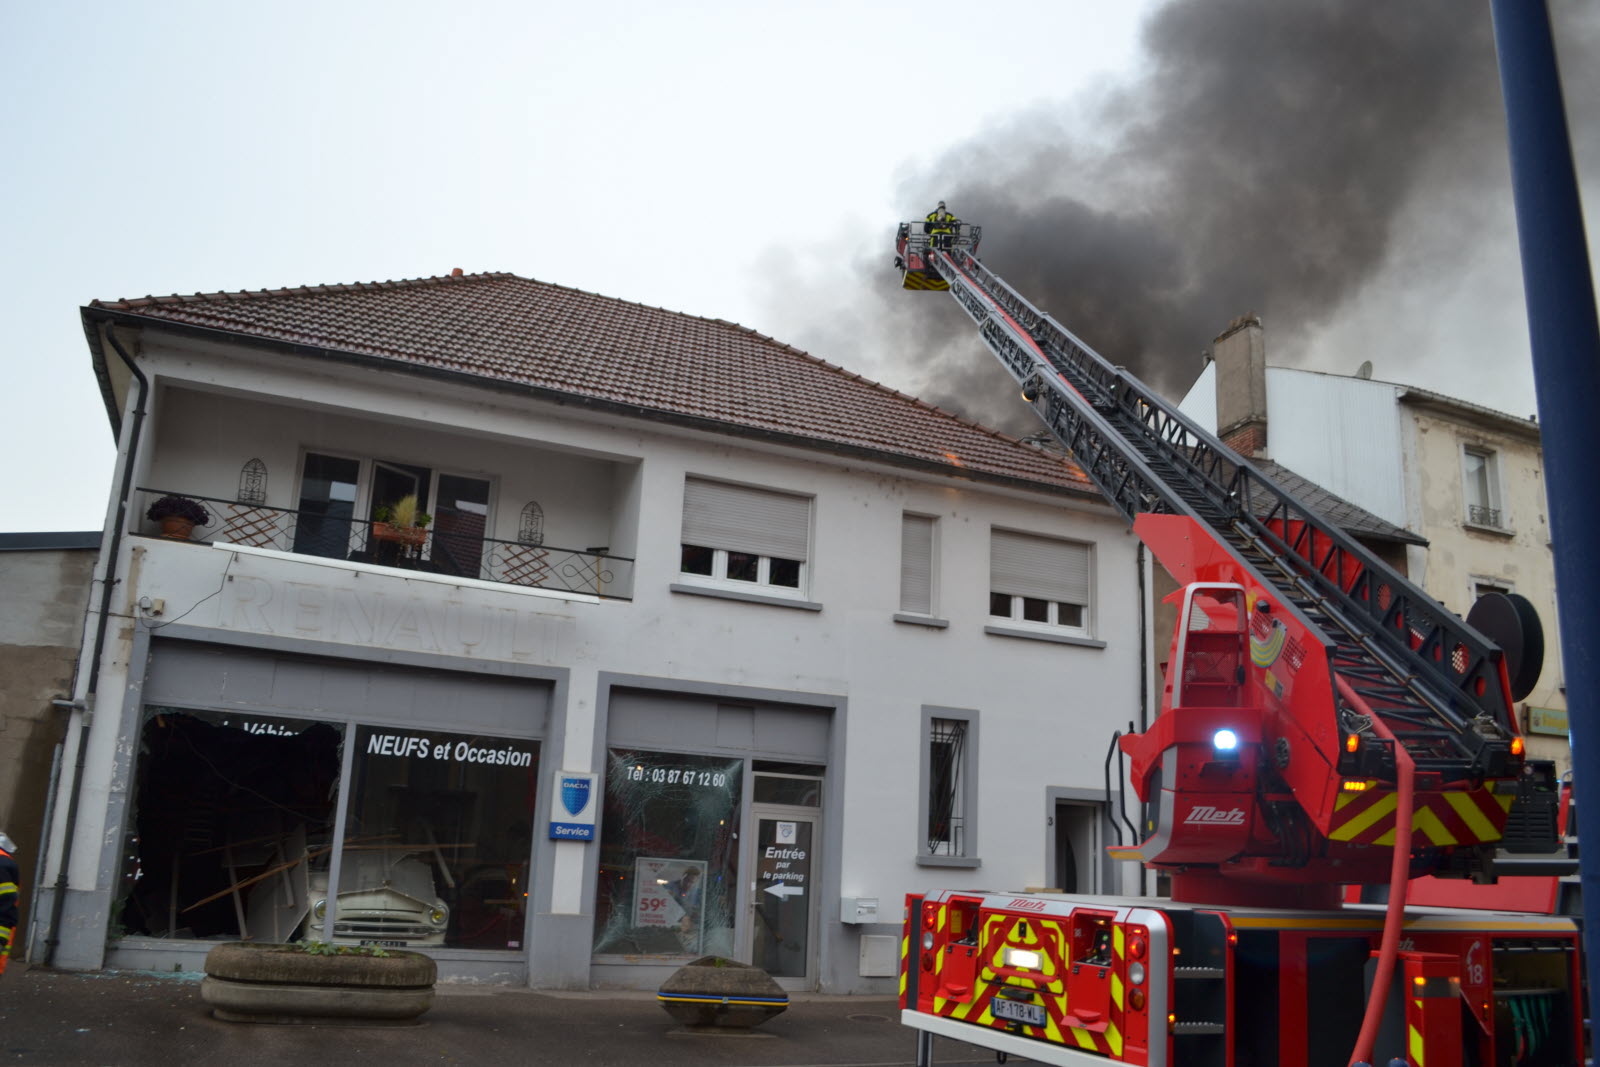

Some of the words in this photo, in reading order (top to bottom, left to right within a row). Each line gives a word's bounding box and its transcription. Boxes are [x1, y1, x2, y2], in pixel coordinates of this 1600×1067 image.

[367, 734, 430, 758] NEUFS
[433, 742, 450, 760] et
[454, 741, 532, 767] Occasion
[652, 768, 665, 782] 03
[667, 770, 681, 783] 87
[683, 771, 696, 784] 67
[698, 772, 711, 786] 12
[712, 773, 725, 787] 60
[1048, 816, 1054, 826] 3
[1184, 806, 1246, 825] Metz
[555, 826, 590, 837] Service
[765, 847, 806, 860] Entrée
[776, 861, 791, 870] par
[763, 871, 771, 879] le
[772, 872, 804, 882] parking
[640, 897, 668, 912] 59€
[1006, 898, 1047, 911] Metz
[1468, 964, 1483, 984] 18
